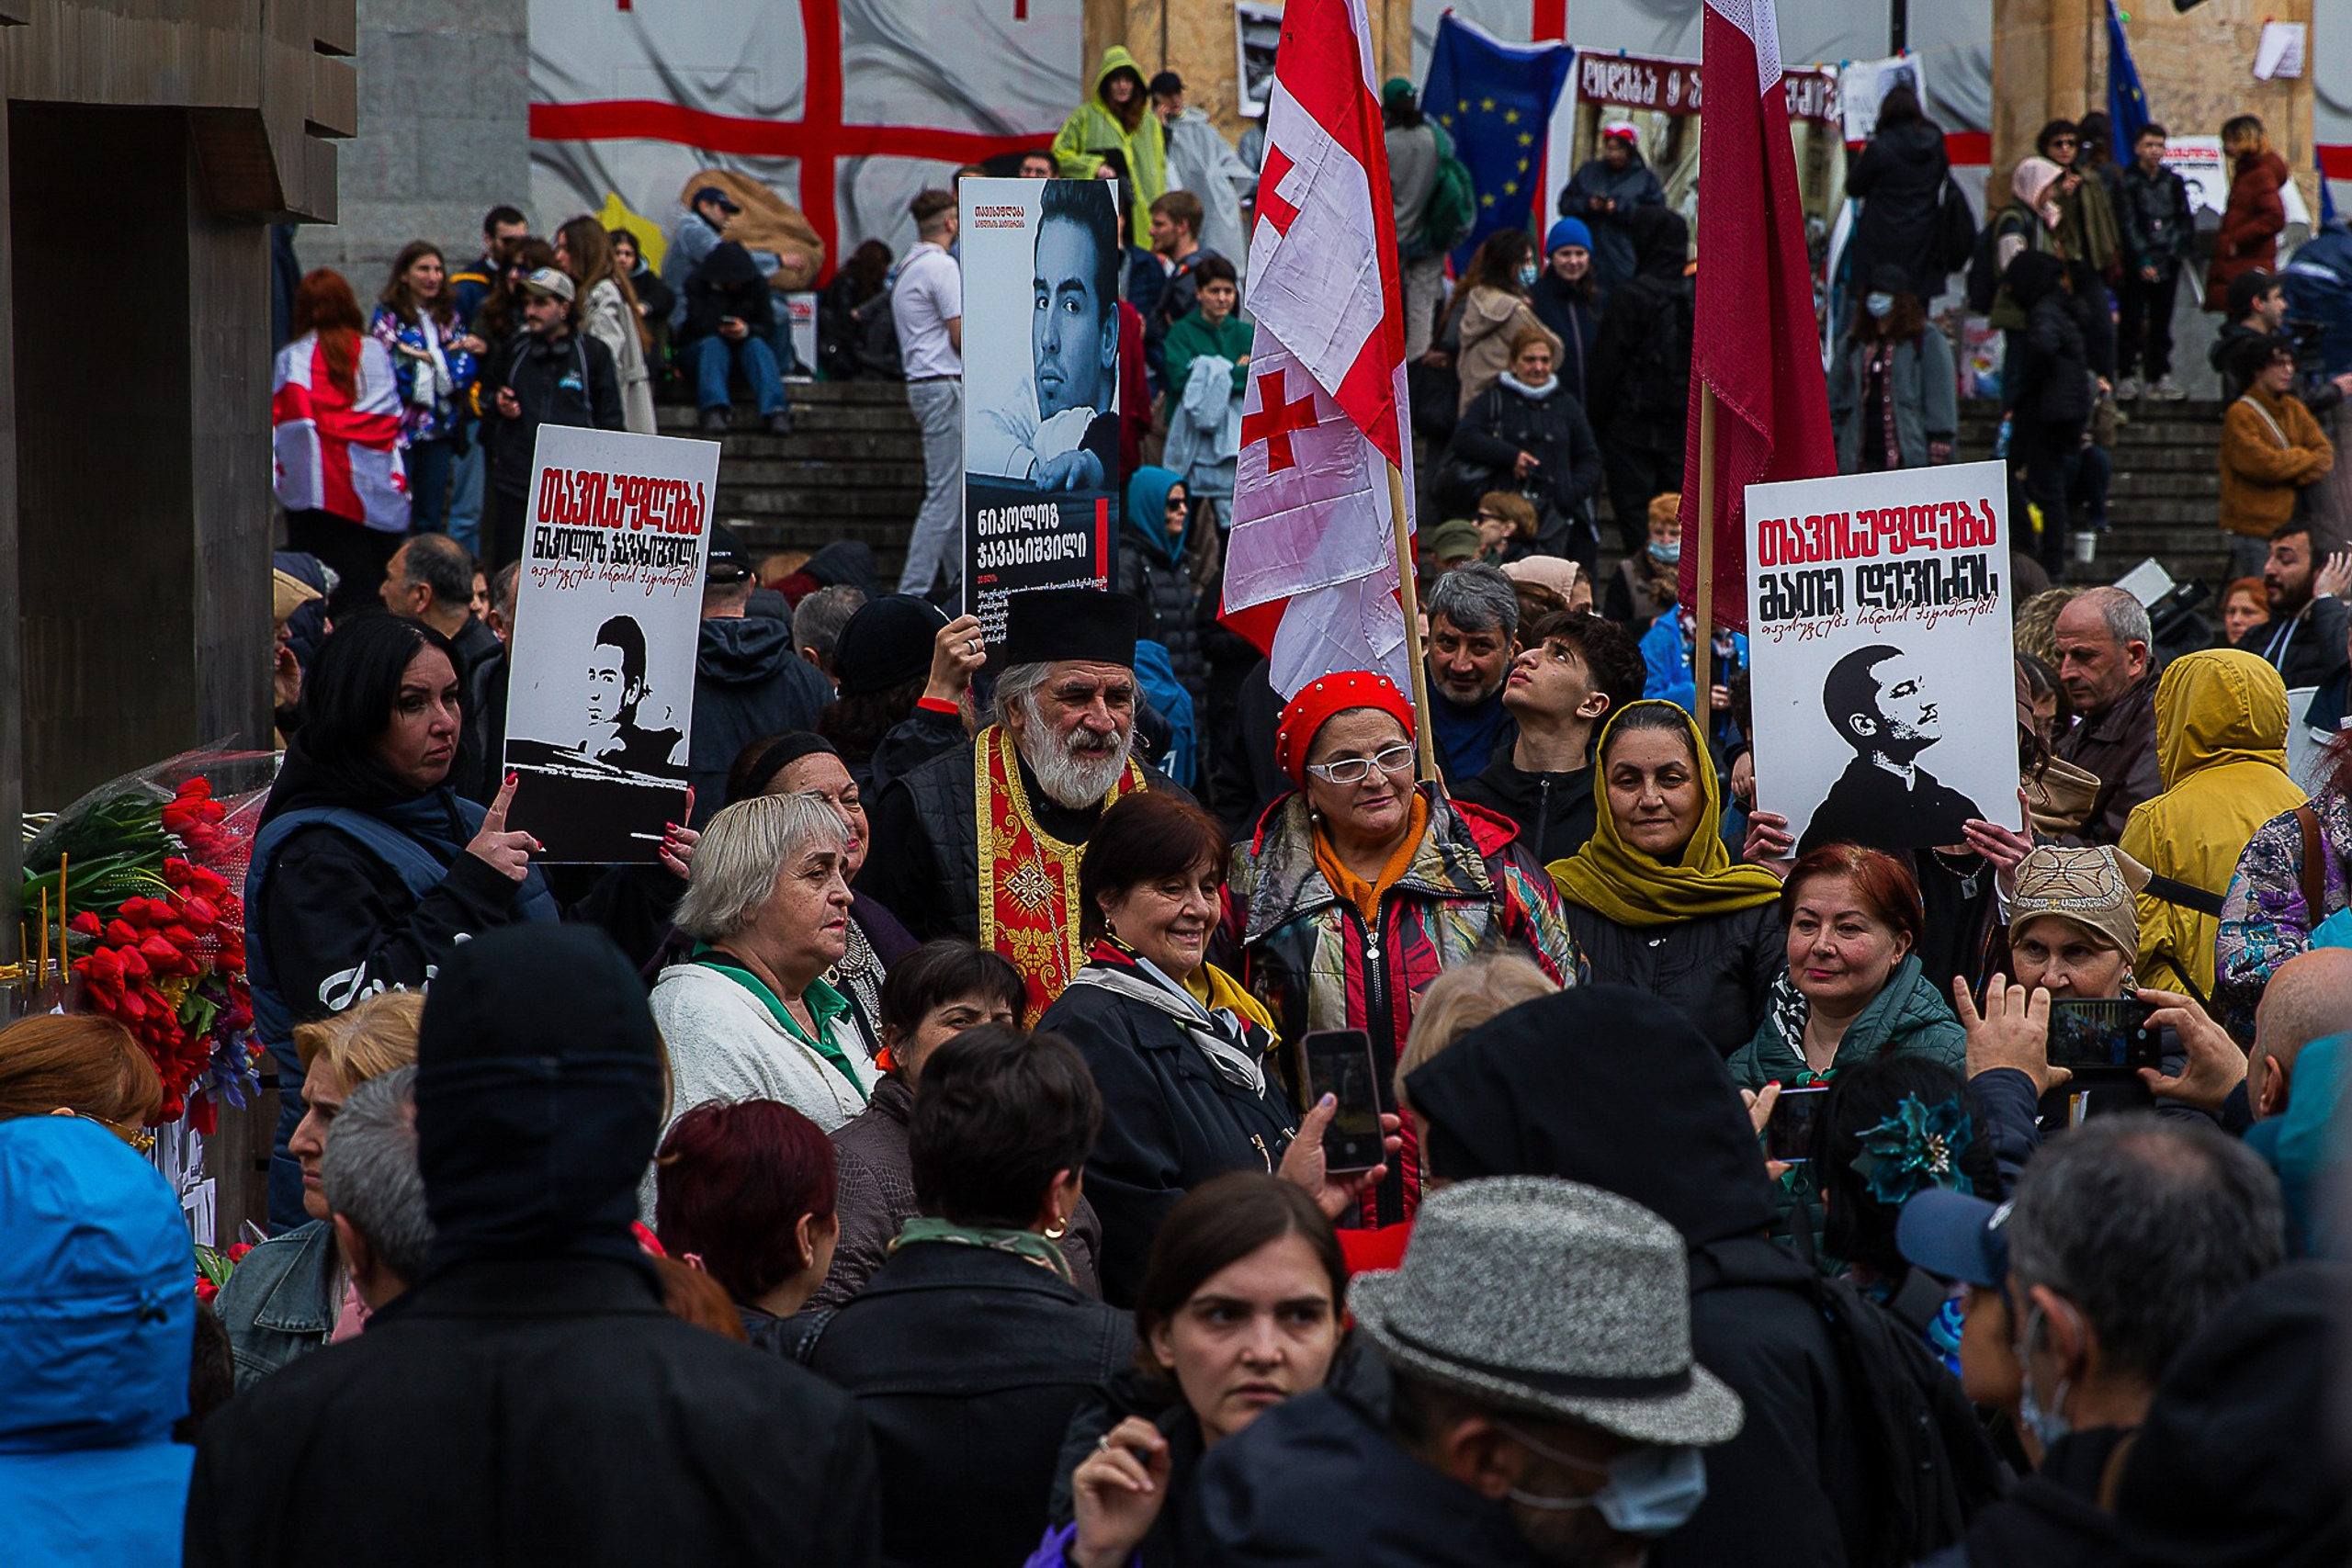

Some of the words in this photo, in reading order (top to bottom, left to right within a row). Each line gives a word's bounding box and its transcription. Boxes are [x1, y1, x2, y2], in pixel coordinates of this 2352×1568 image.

[537, 468, 705, 535] თავისუფლება
[978, 502, 1060, 536] ნიკოლოზ
[532, 525, 607, 564] ნიკოლოზ
[978, 532, 1087, 569] ჯავახიშვილი
[1758, 499, 1996, 567] თავისუფლება
[1758, 567, 1844, 622] მათე
[1856, 553, 1998, 610] დევიძეს
